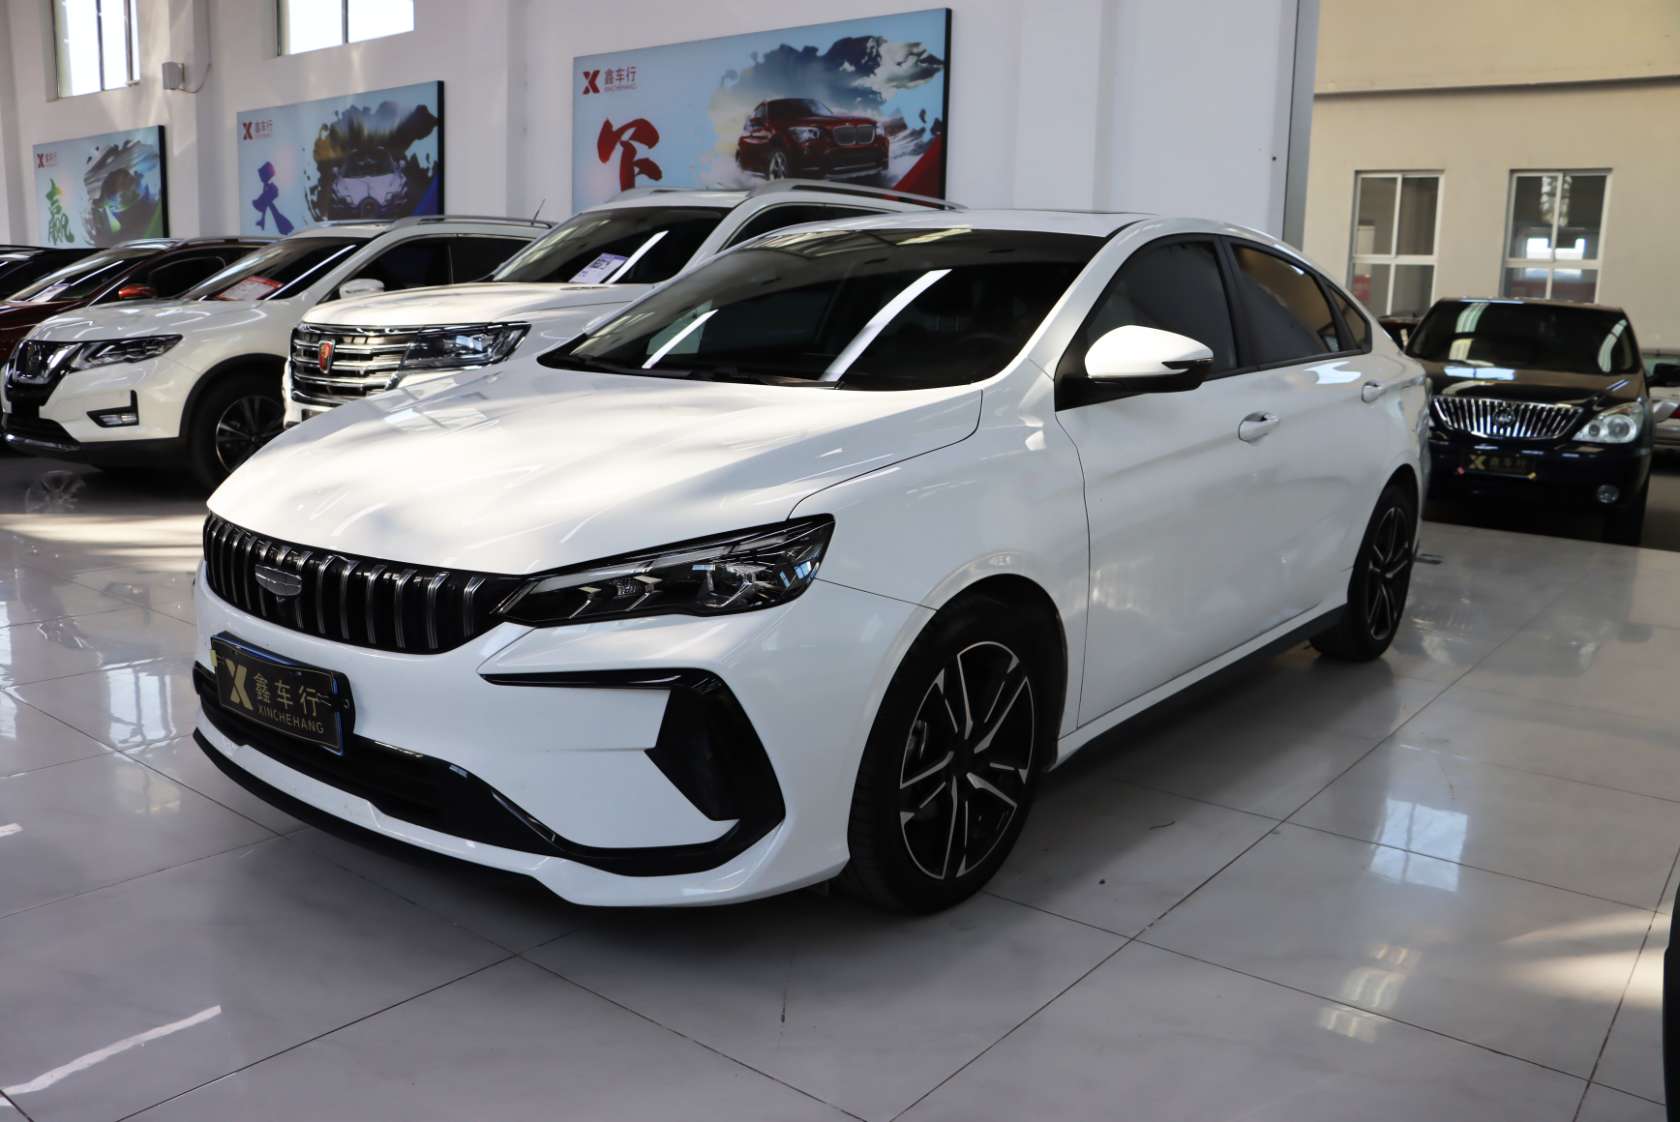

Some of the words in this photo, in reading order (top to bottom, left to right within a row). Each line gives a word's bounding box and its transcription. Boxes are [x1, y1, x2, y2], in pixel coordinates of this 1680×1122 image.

[604, 66, 637, 85] 鑫车行
[254, 672, 319, 717] 鑫车行
[257, 705, 325, 735] XINCHEHANG
